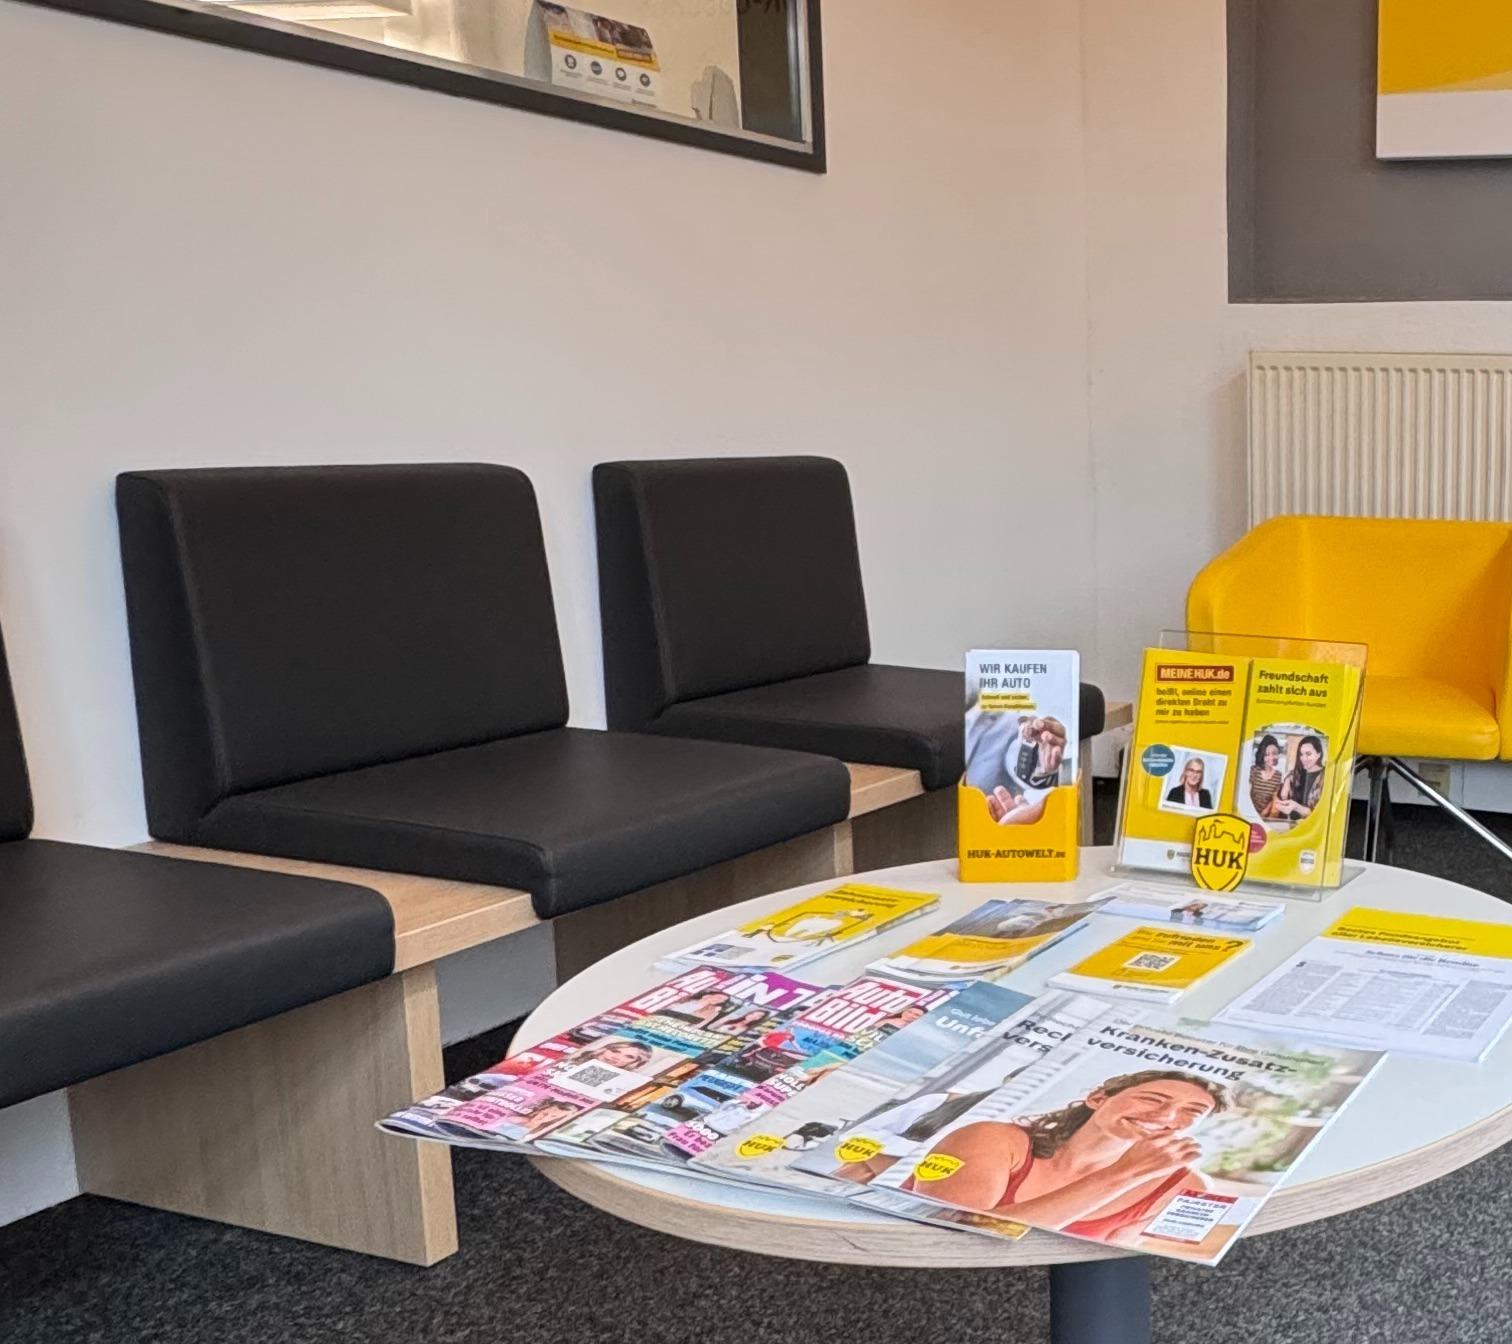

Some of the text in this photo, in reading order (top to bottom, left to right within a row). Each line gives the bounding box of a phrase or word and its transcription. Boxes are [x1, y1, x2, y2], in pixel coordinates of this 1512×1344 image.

[979, 664, 1048, 674] WIR KAUFEN
[1259, 670, 1329, 684] Freundschaft
[979, 678, 1032, 689] IHR AUTO
[1257, 684, 1328, 698] zahlt sich aus
[1194, 847, 1245, 870] HUK
[840, 981, 921, 1014] Auto
[803, 997, 888, 1033] Bild
[1100, 1025, 1297, 1074] Kranken-Zusatz-
[1087, 1037, 1246, 1082] versicherung
[742, 1139, 779, 1154] HUK
[840, 1140, 874, 1157] HUK
[919, 1159, 955, 1175] HUK
